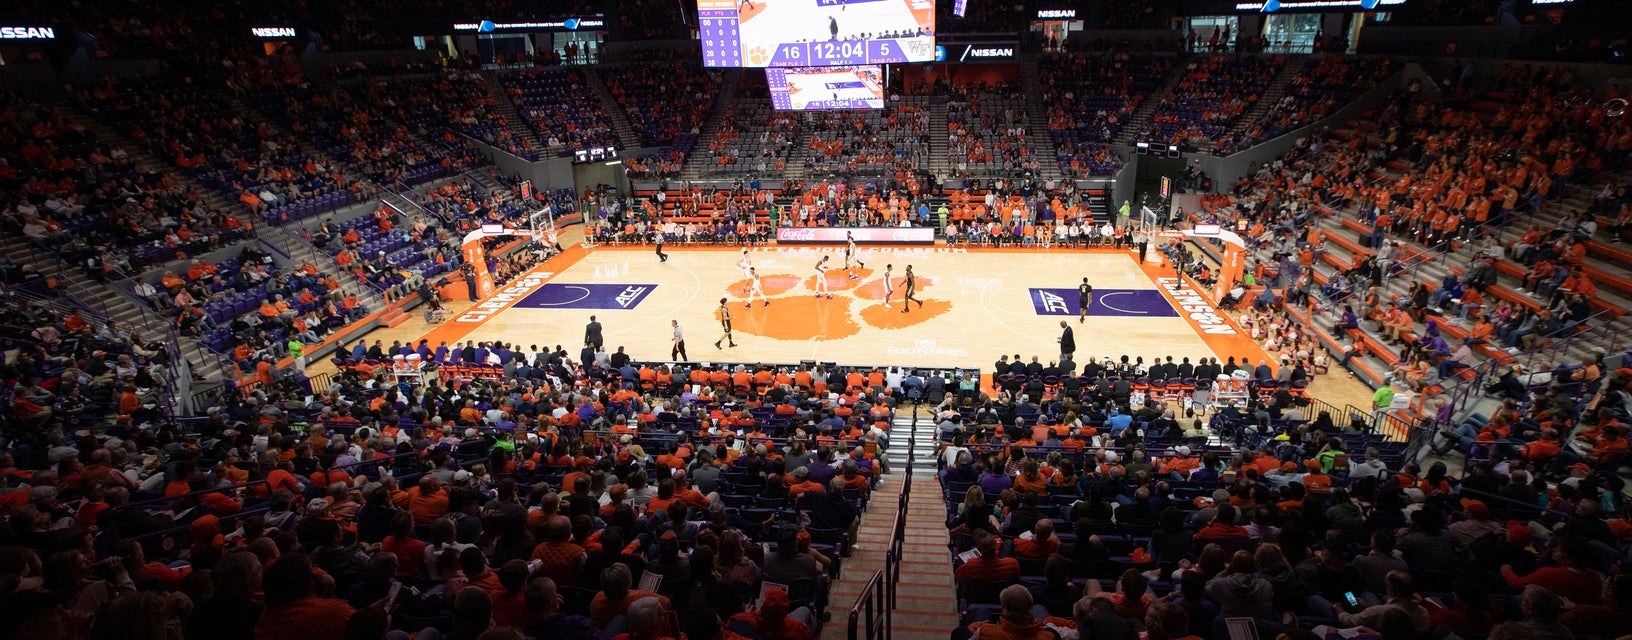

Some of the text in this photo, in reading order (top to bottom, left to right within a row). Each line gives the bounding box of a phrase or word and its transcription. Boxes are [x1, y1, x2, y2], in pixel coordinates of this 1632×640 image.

[252, 27, 296, 39] NISSAN
[706, 39, 713, 47] 10
[782, 46, 800, 59] 16
[814, 42, 863, 59] 12:04
[880, 43, 889, 56] 5
[971, 48, 1012, 57] NISSAN
[456, 271, 555, 322] CLEMSON
[615, 285, 643, 306] ACC
[1044, 291, 1070, 314] ACC
[1156, 277, 1238, 335] CLEMSON
